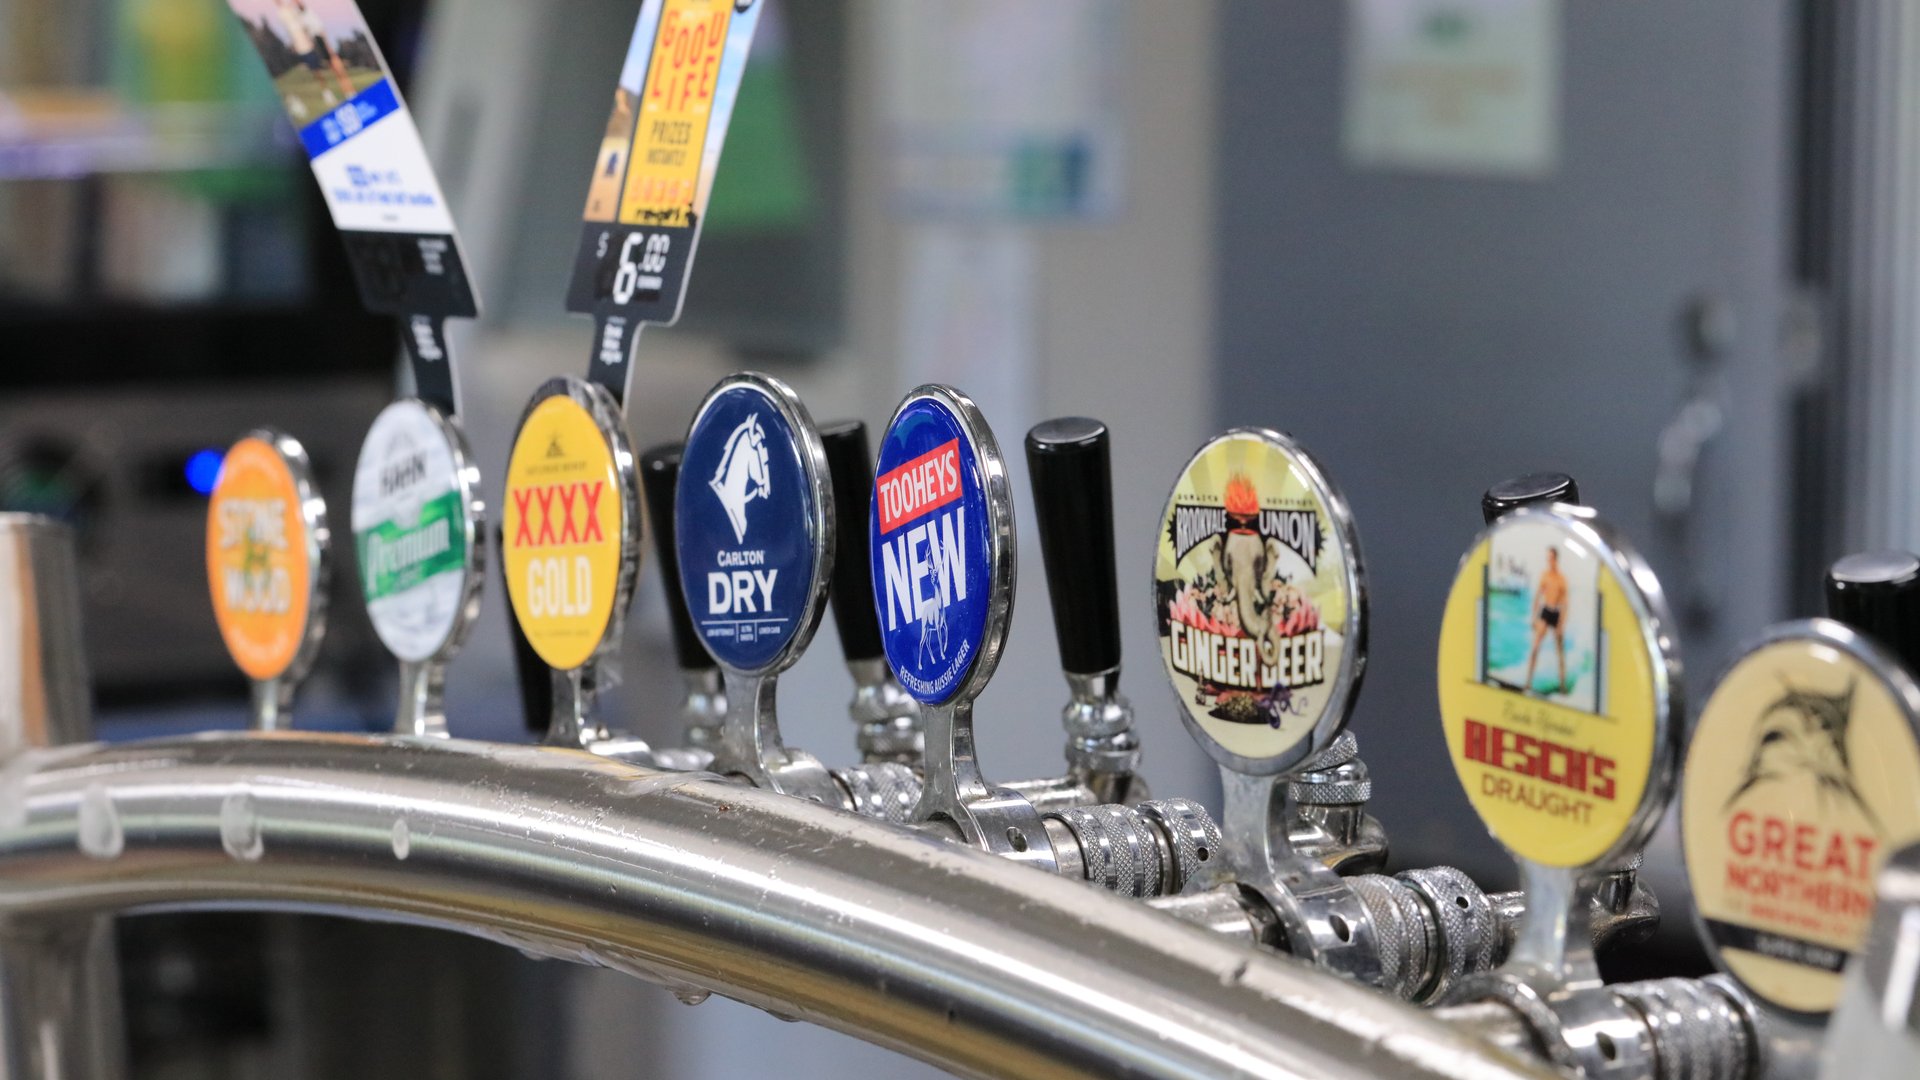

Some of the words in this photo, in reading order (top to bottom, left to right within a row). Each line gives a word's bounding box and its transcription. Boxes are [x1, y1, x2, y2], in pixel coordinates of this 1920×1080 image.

[660, 9, 725, 69] GOOD
[651, 55, 715, 112] LIFE
[513, 480, 604, 549] XXXX
[879, 449, 958, 524] TOOHEYS
[717, 550, 765, 567] CARLTON
[881, 504, 967, 632] NEW
[1176, 507, 1228, 557] BROOKVALE
[1258, 510, 1317, 569] UNION
[526, 555, 593, 618] GOLD
[708, 569, 778, 615] DRY
[900, 665, 935, 695] REFRESHING
[934, 667, 954, 693] AUSSIE
[951, 638, 970, 676] LAGER
[1171, 620, 1258, 690] GINGER
[1464, 718, 1617, 801] RESCH'S
[1482, 772, 1595, 824] DRAUGHT
[1727, 809, 1879, 883] GREAT
[1725, 861, 1875, 920] NORTHERN
